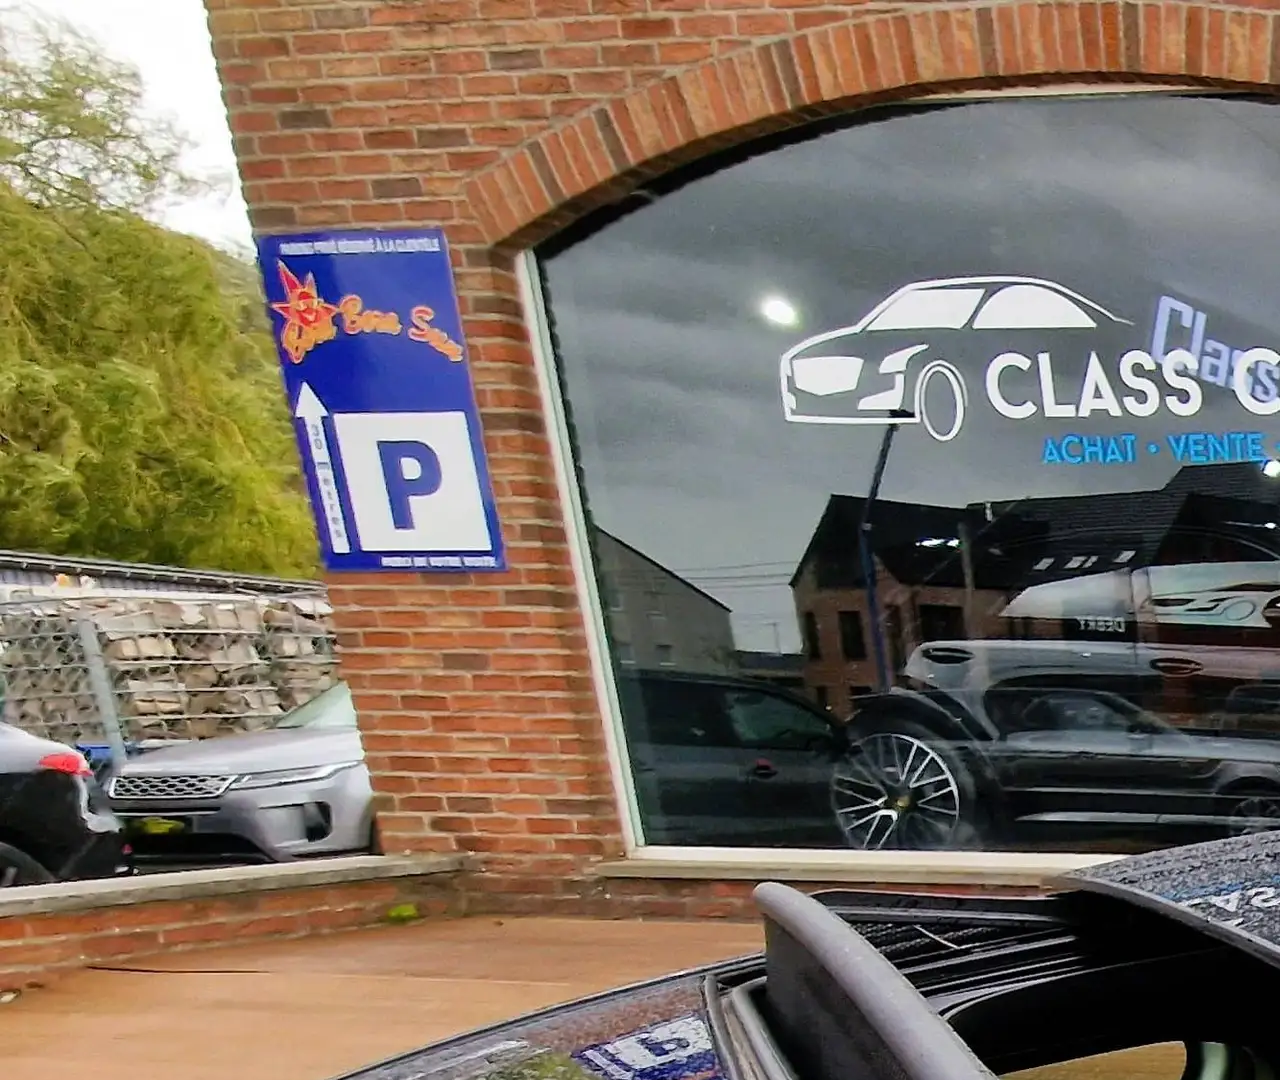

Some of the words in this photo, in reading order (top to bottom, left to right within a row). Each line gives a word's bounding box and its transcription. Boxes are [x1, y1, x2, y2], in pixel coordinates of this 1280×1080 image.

[985, 348, 1203, 419] CLASS
[1042, 434, 1137, 464] ACHAT
[1167, 431, 1268, 463] VENTE
[376, 439, 443, 531] P
